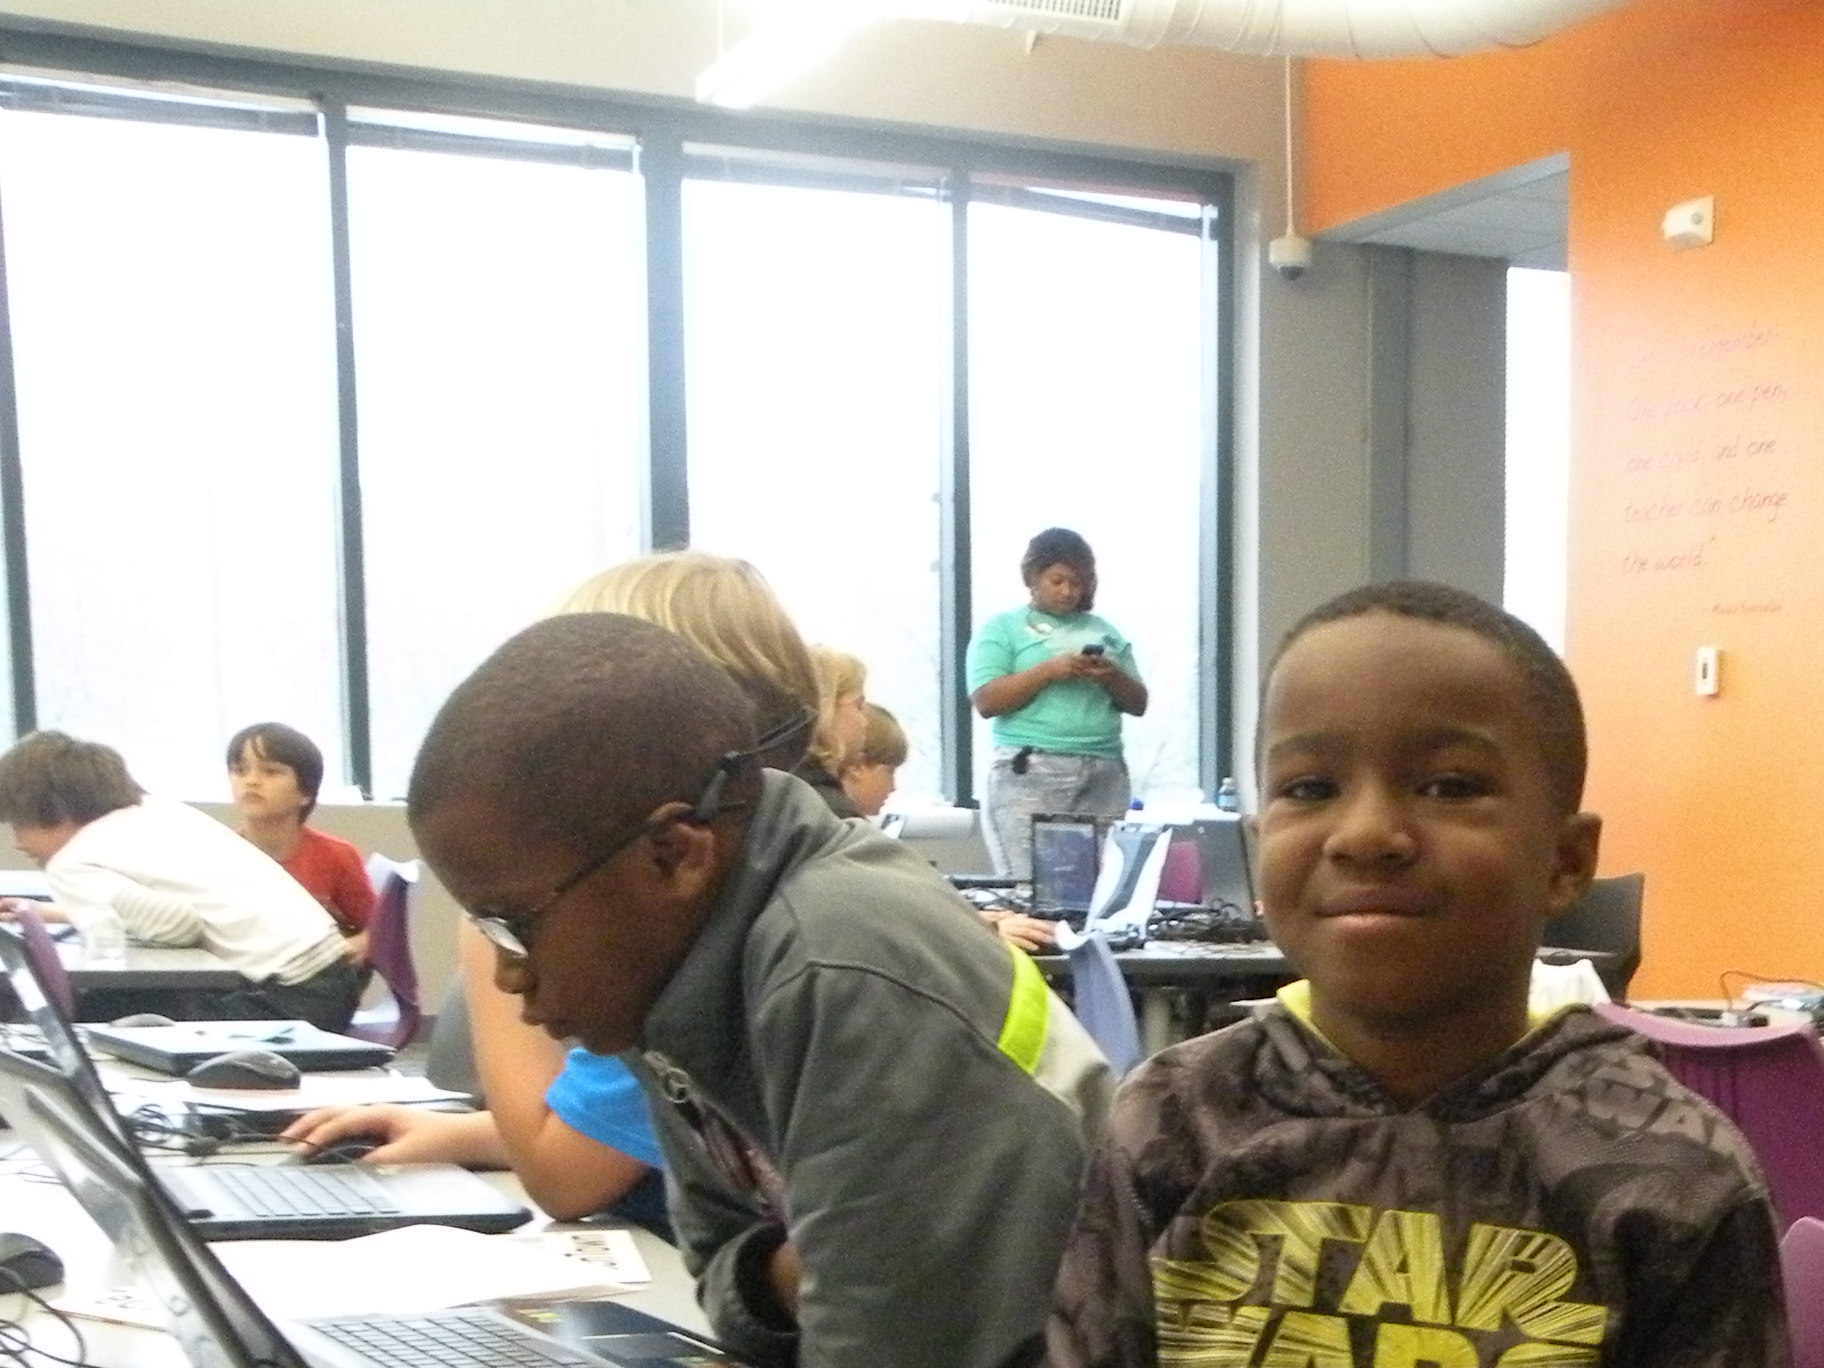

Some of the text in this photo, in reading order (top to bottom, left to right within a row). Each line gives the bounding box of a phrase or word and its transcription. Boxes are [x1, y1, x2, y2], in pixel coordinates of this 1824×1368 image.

[1746, 438, 1777, 459] one
[1622, 486, 1789, 524] teacher can change
[1621, 550, 1651, 576] the
[1150, 1198, 1609, 1344] STAR
